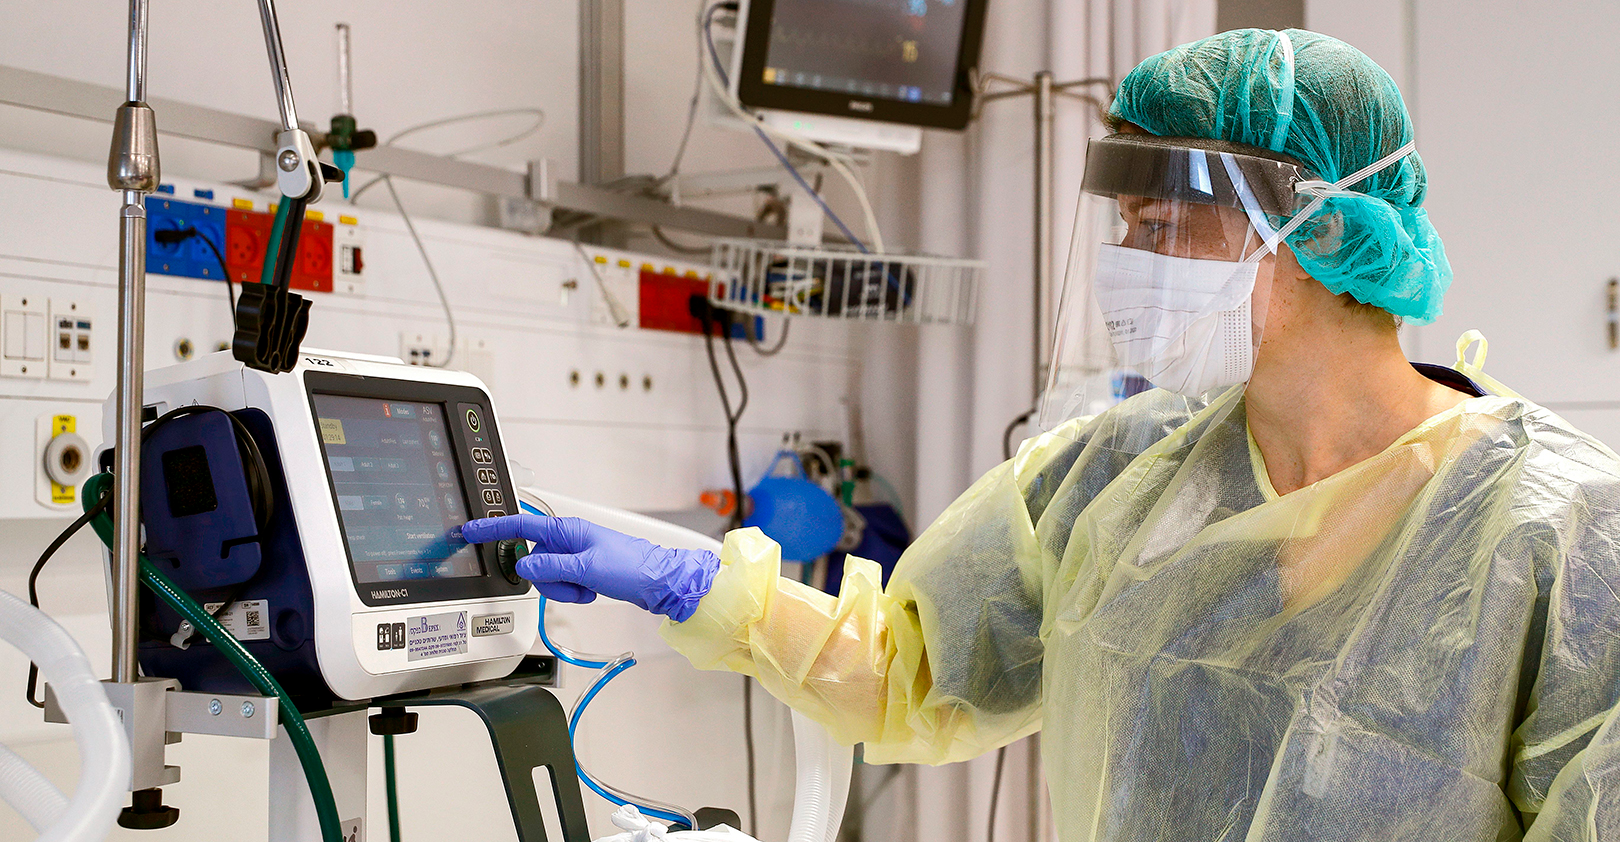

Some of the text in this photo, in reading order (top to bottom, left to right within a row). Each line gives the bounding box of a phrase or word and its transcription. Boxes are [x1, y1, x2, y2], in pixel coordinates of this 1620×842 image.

[305, 358, 334, 366] 122
[422, 406, 433, 414] ASV
[384, 567, 396, 575] Tools
[410, 566, 423, 574] Events
[371, 588, 408, 599] HAMILTON-C1
[485, 616, 510, 626] HAMILTON
[476, 625, 500, 634] MEDICAL
